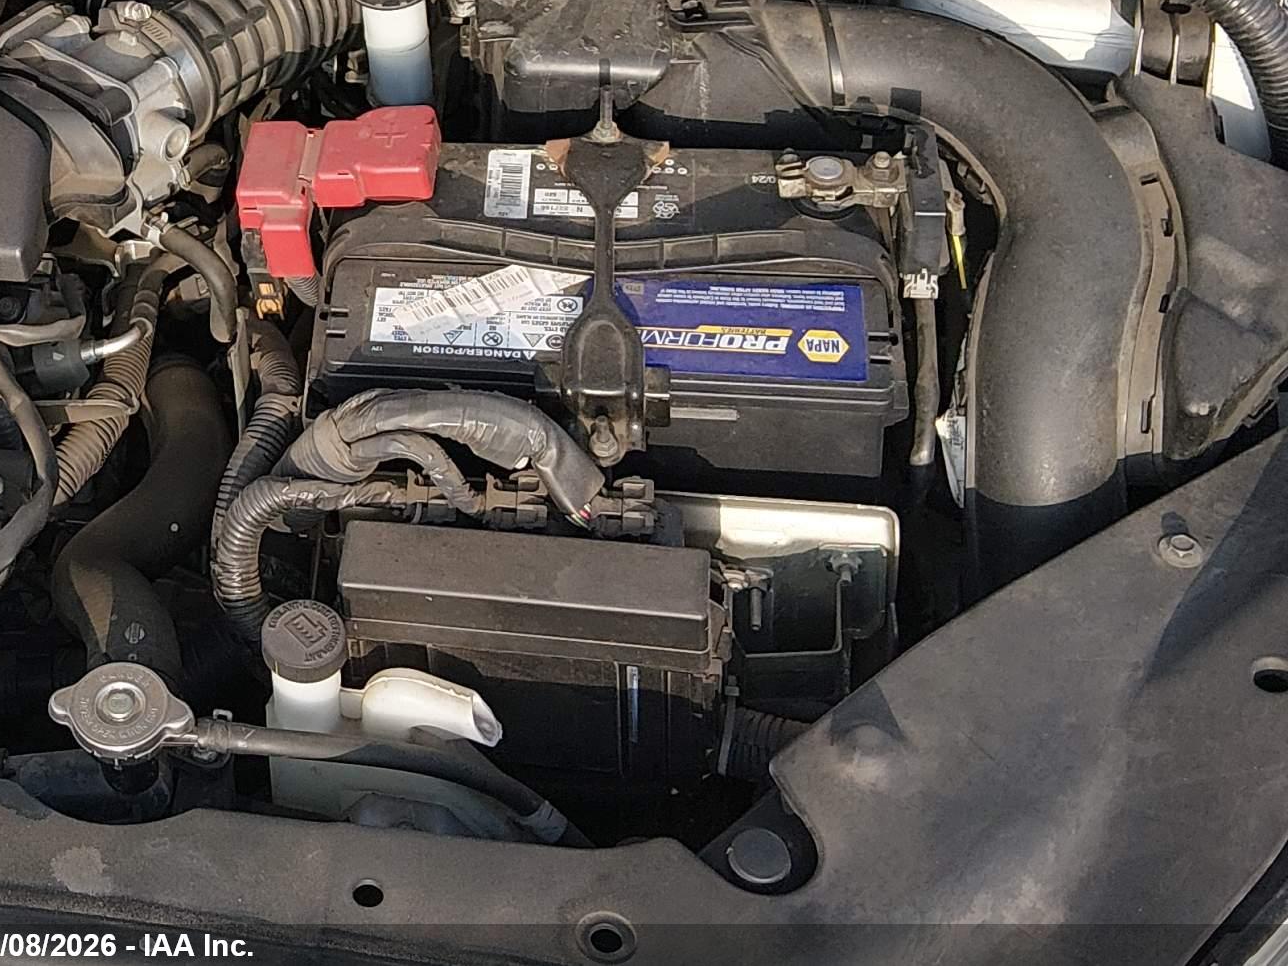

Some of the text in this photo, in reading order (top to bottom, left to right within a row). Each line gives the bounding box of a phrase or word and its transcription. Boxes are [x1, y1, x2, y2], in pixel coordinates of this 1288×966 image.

[638, 328, 789, 351] PROFORM
[806, 338, 840, 354] NAPA
[412, 345, 521, 359] DANGER/POISON
